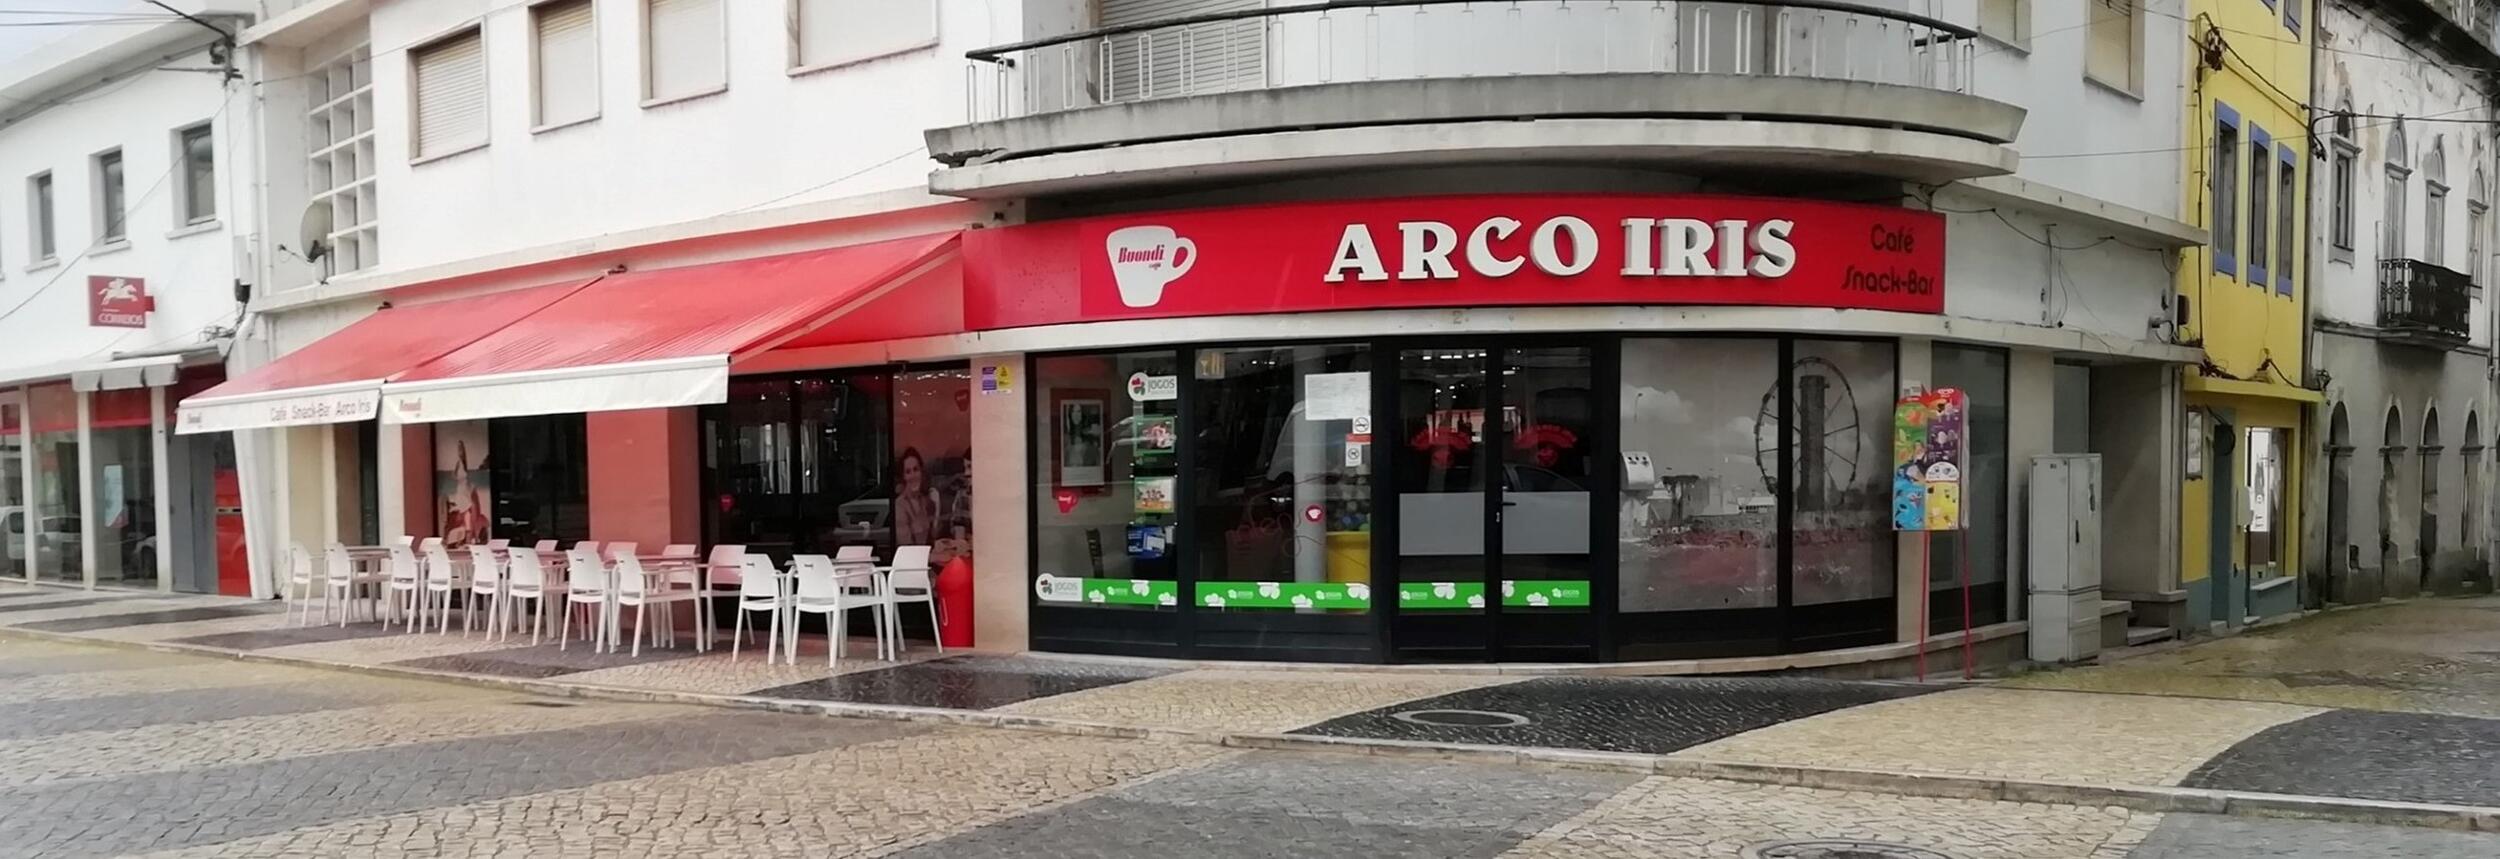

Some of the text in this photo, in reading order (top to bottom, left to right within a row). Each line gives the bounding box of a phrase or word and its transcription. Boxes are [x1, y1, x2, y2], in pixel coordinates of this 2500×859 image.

[1118, 244, 1165, 263] Buondi
[1324, 215, 1797, 283] ARCO IRIS
[1870, 223, 1914, 254] Café
[1841, 264, 1936, 295] Snack-Bar
[1147, 379, 1175, 393] JOGOS
